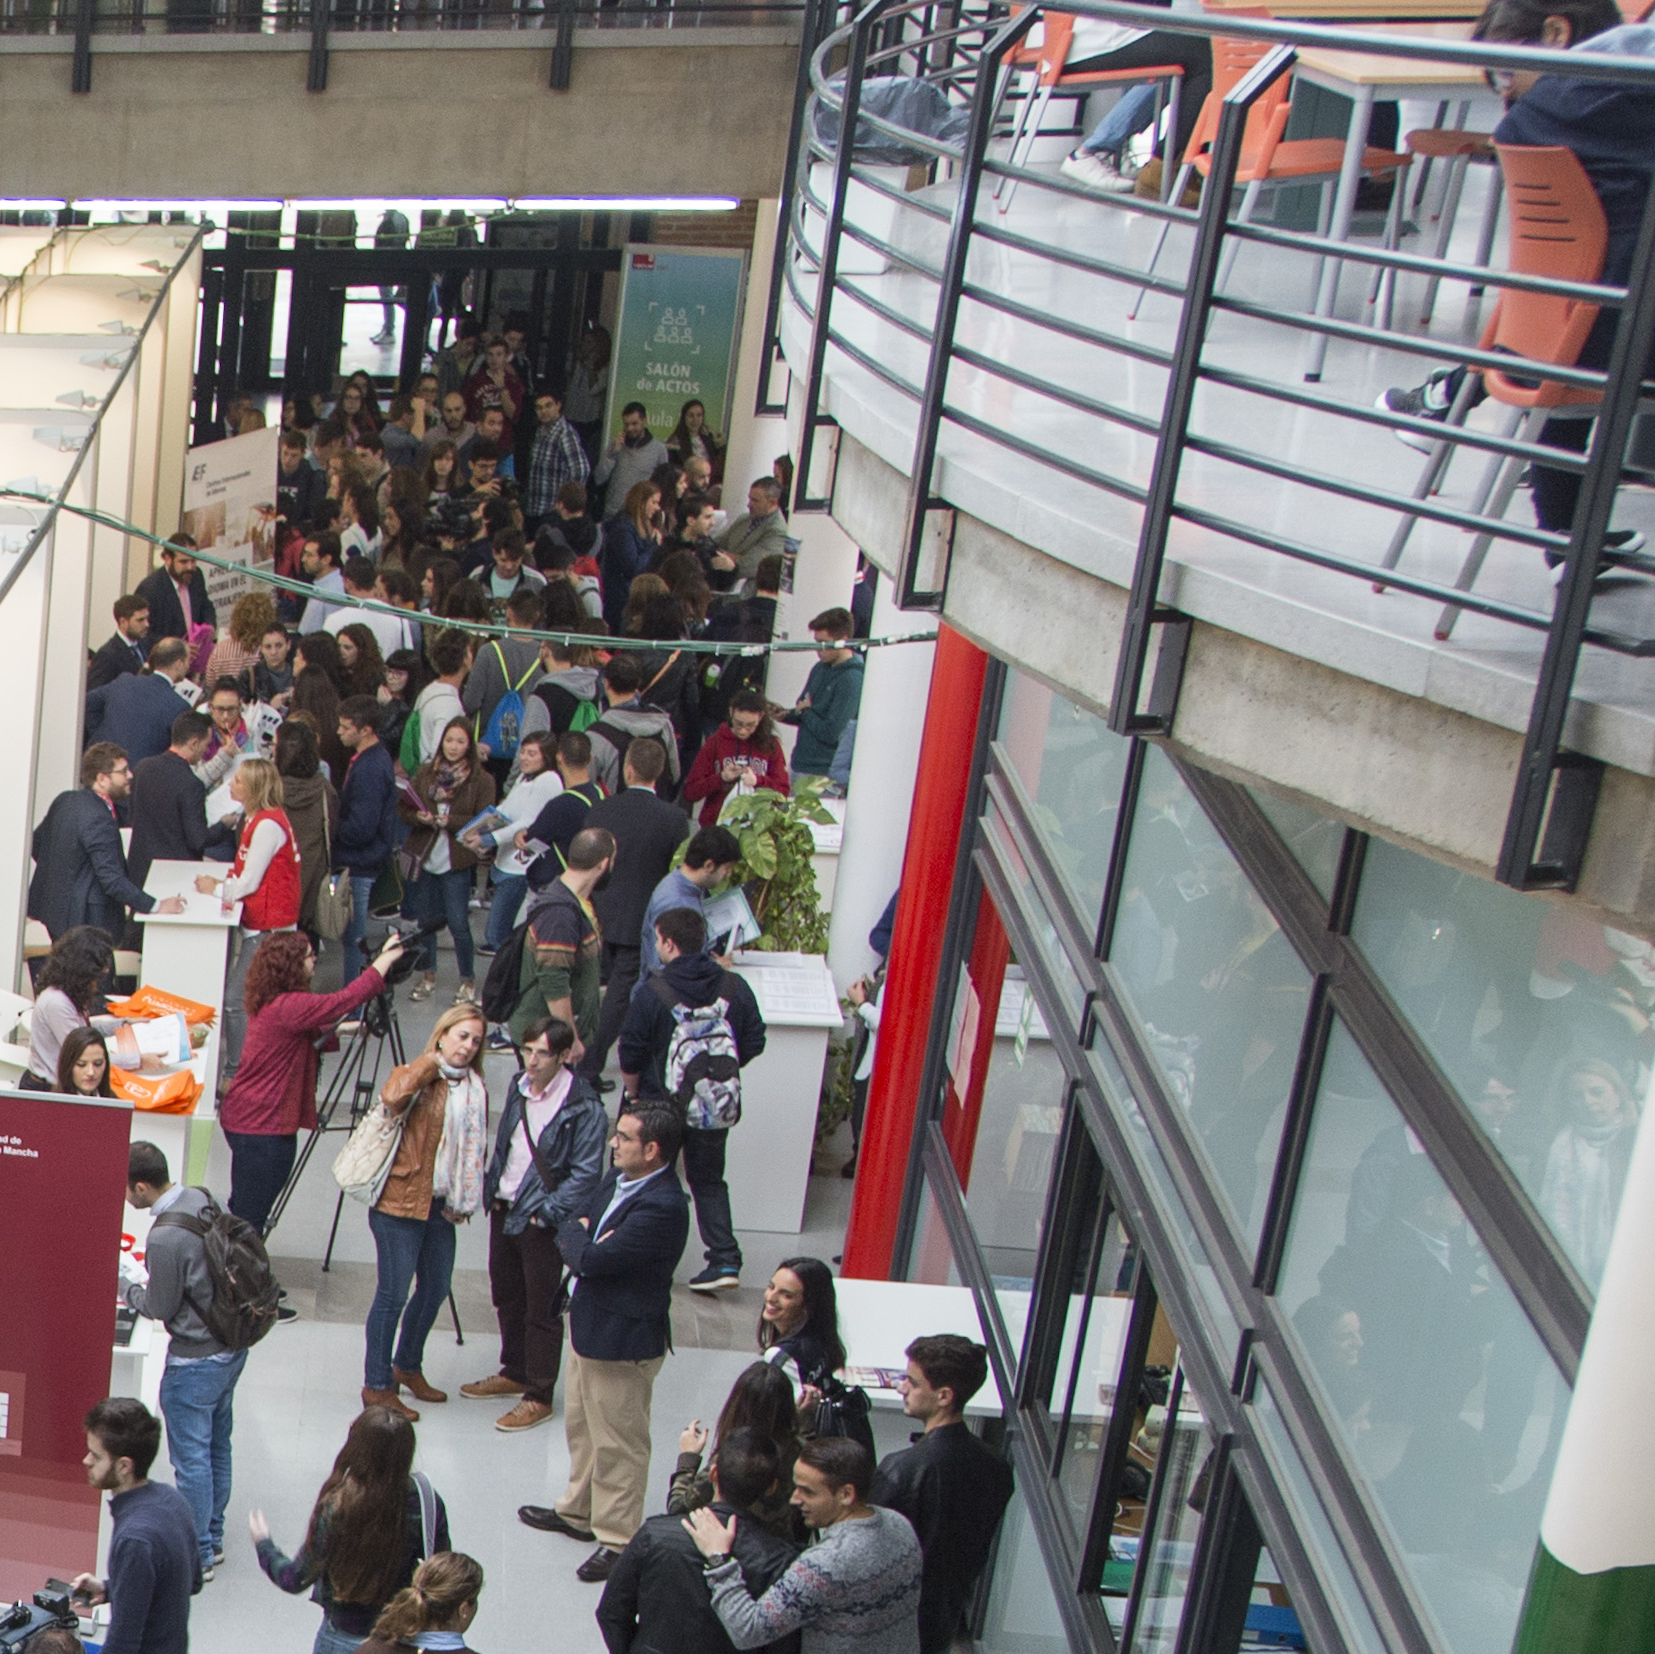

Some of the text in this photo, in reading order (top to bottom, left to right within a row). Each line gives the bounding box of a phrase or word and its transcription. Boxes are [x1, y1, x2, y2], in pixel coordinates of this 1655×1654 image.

[645, 361, 691, 377] SALÓN
[637, 378, 700, 394] de ACTOS
[647, 409, 674, 427] ula
[192, 463, 207, 481] EF
[10, 1136, 22, 1145] de
[3, 1145, 39, 1158] Mancha
